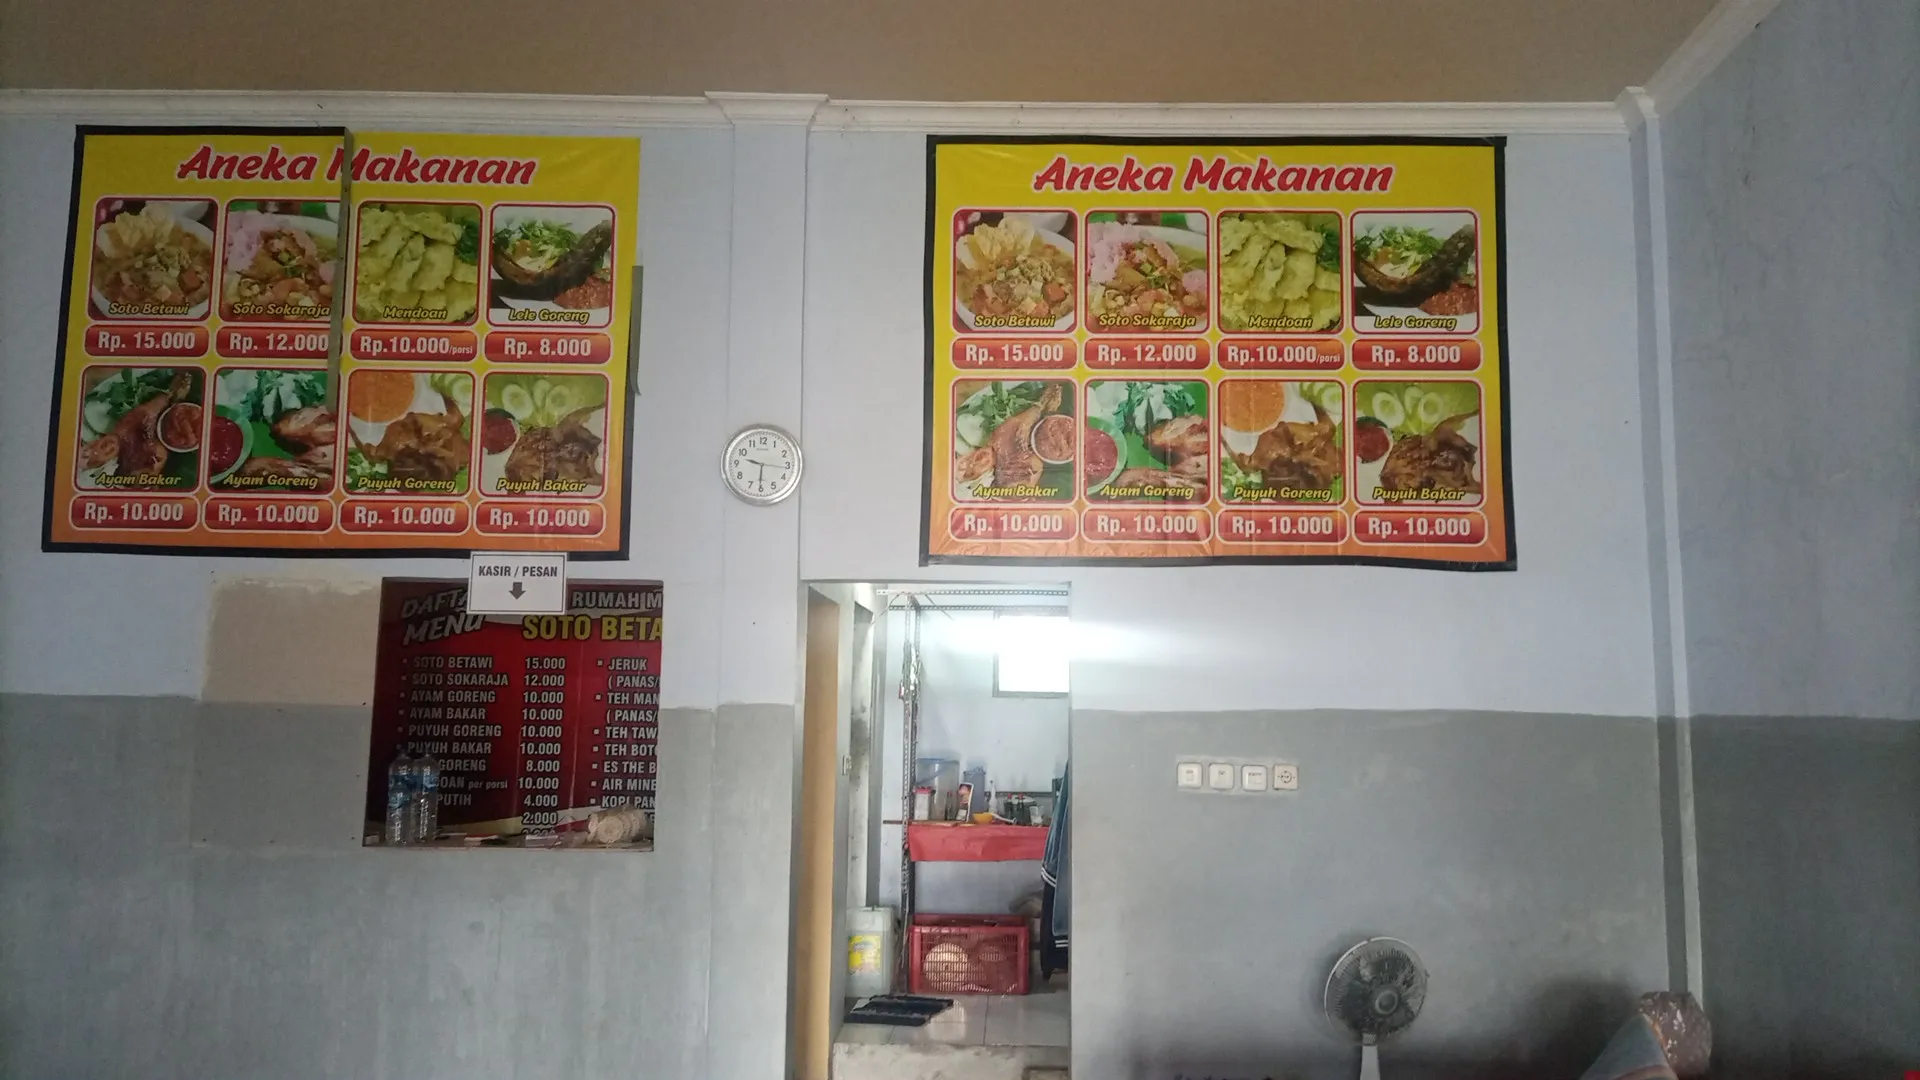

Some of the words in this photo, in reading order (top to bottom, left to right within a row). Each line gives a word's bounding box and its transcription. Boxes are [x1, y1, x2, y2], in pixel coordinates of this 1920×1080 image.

[177, 145, 318, 181] Aneka
[326, 147, 537, 185] Makanan
[1033, 157, 1174, 192] Aneka
[1182, 157, 1394, 192] Makanan
[108, 302, 140, 315] Soto
[143, 302, 190, 316] Betawi
[232, 302, 262, 316] Soto
[266, 303, 331, 318] Sokaraja
[384, 306, 447, 321] Mendoan
[508, 308, 536, 322] Lele
[539, 309, 590, 325] Goreng
[974, 315, 1005, 328] Soto
[1008, 315, 1056, 328] Betawi
[1099, 314, 1129, 327] Soto
[1132, 315, 1196, 329] Sokaraja
[1249, 315, 1312, 329] Mendoan
[1374, 316, 1402, 329] Lele
[1405, 316, 1457, 331] Goreng
[98, 332, 126, 353] Rp.
[134, 332, 195, 350] 15.000
[230, 333, 258, 354] Rp.
[266, 333, 329, 352] 12.000
[504, 337, 533, 359] Rp.
[539, 338, 591, 357] 8.000
[965, 344, 993, 365] Rp.
[1001, 344, 1064, 362] 15.000
[1098, 344, 1126, 365] Rp.
[1134, 344, 1197, 363] 12.000
[1371, 346, 1400, 366] Rp.
[1408, 346, 1461, 363] 8.000
[749, 440, 756, 448] 11
[760, 437, 767, 445] 12
[739, 448, 747, 456] 10
[781, 450, 787, 458] 2
[96, 474, 137, 488] Ayam
[139, 474, 182, 486] Bakar
[223, 474, 264, 488] Ayam
[267, 475, 319, 489] Goreng
[737, 472, 743, 480] 8
[358, 477, 402, 491] Puyuh
[404, 477, 455, 491] Goreng
[496, 478, 540, 492] Puyuh
[543, 479, 586, 492] Bakar
[748, 481, 753, 489] 7
[771, 482, 776, 490] 5
[973, 484, 1014, 498] Ayam
[1016, 485, 1059, 497] Bakar
[1100, 485, 1141, 498] Ayam
[1144, 486, 1195, 499] Goreng
[1233, 486, 1277, 500] Puyuh
[1280, 487, 1331, 501] Goreng
[1372, 487, 1417, 501] Puyuh
[1420, 488, 1465, 500] Bakar
[84, 502, 113, 523] Rp.
[121, 502, 183, 521] 10.000
[218, 504, 247, 525] Rp.
[255, 504, 319, 523] 10.000
[354, 506, 383, 527] Rp.
[391, 507, 456, 526] 10.000
[490, 508, 518, 529] Rp.
[527, 509, 590, 527] 10.000
[964, 514, 993, 535] Rp.
[1000, 514, 1063, 532] 10.000
[1097, 514, 1126, 536] Rp.
[1134, 515, 1197, 534] 10.000
[1232, 516, 1261, 537] Rp.
[1269, 517, 1333, 535] 10.000
[1368, 517, 1398, 538] Rp.
[1405, 517, 1471, 536] 10.000
[478, 565, 511, 578] KASIR
[513, 566, 519, 578] /
[522, 566, 558, 578] PESAN
[572, 591, 640, 608] RUMAH
[402, 612, 484, 646] MENU
[523, 615, 590, 640] SOTO
[601, 616, 662, 641] BETA
[414, 656, 444, 668] SOTO
[448, 657, 493, 668] BETAWI
[525, 657, 565, 669] 15.000
[608, 658, 648, 670] JERUK
[412, 673, 443, 685] SOTO
[447, 674, 509, 686] SOKARAJA
[524, 675, 565, 687] 12.000
[616, 675, 660, 688] PANAS/
[410, 691, 443, 702] AYAM
[447, 691, 496, 703] GORENG
[523, 692, 564, 703] 10.000
[607, 692, 629, 704] TEH
[410, 708, 442, 719] AYAM
[446, 708, 486, 720] BAKAR
[522, 709, 563, 720] 10.000
[408, 725, 449, 736] PUYUH
[453, 725, 502, 737] GORENG
[521, 726, 562, 737] 10.000
[605, 726, 628, 738] TEH
[632, 727, 658, 739] TAW
[407, 742, 448, 753] PUYUH
[452, 742, 492, 754] BAKAR
[519, 743, 561, 755] 10.000
[604, 743, 627, 755] TEH
[526, 760, 560, 772] 8.000
[603, 761, 618, 773] ES
[622, 761, 645, 773] THE
[468, 780, 483, 791] per
[486, 779, 508, 791] porsi
[518, 777, 559, 789] 10.000
[602, 778, 623, 790] AIR
[524, 795, 558, 807] 4.000
